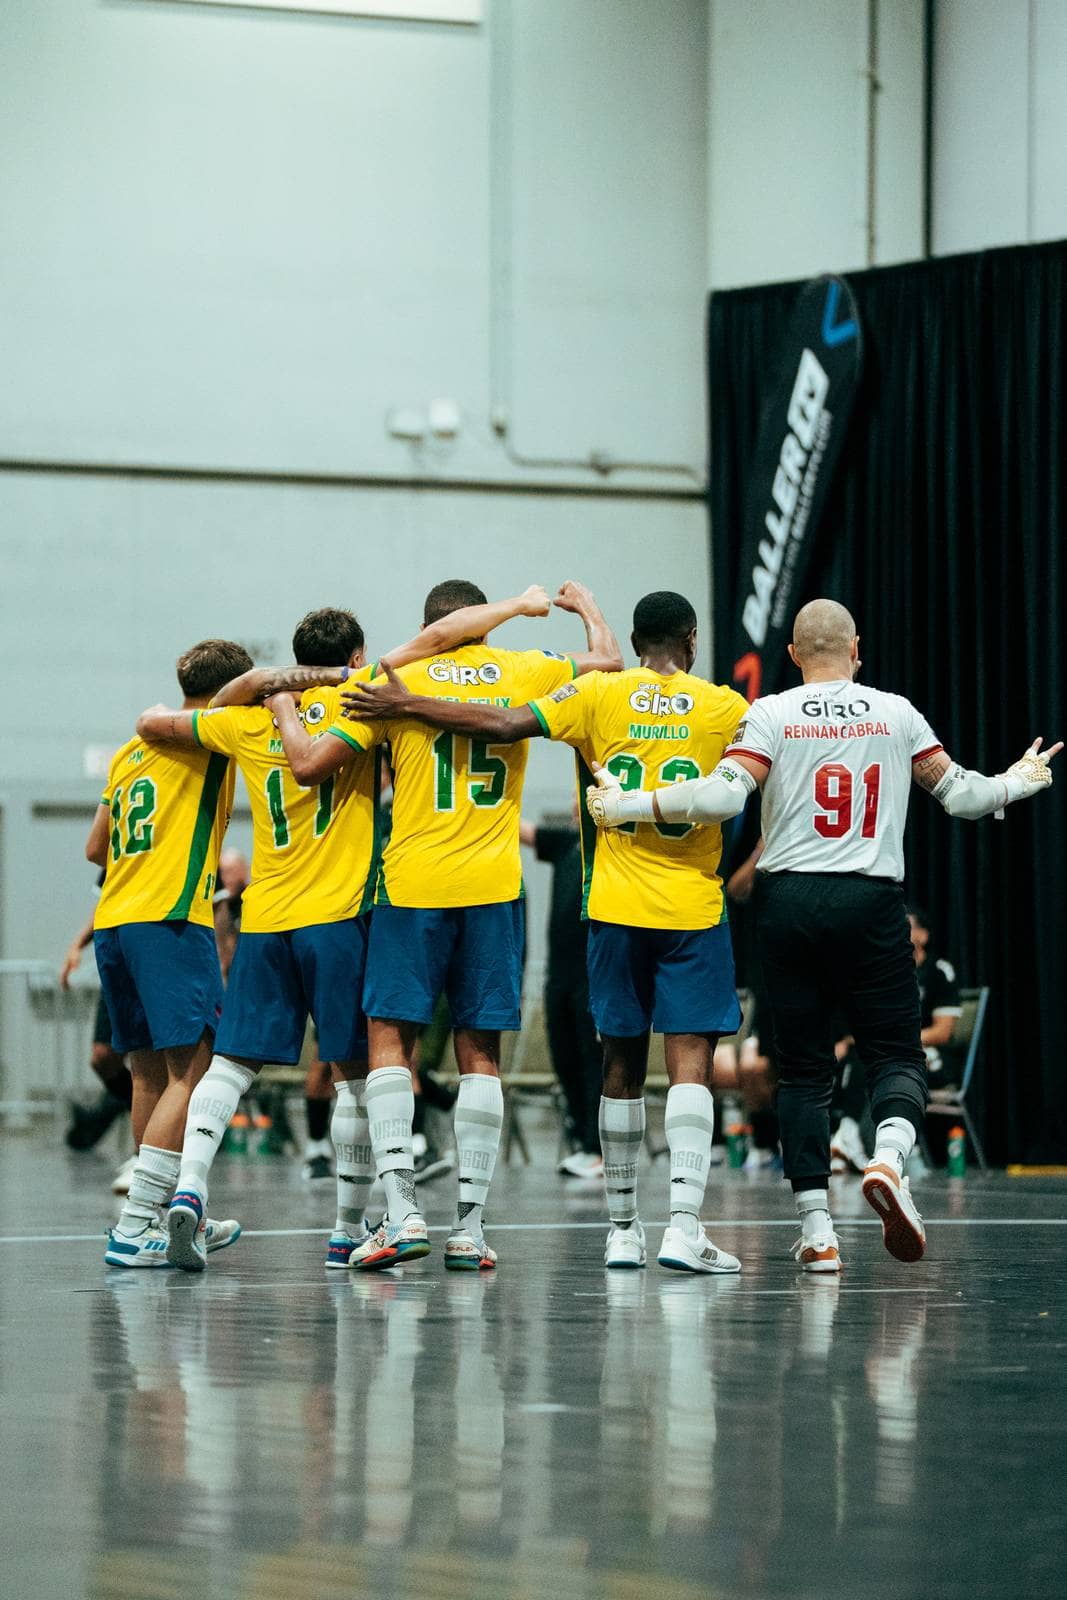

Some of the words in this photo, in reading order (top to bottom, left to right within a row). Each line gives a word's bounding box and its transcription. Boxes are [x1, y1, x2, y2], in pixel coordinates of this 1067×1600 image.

[428, 662, 502, 685] GIRO
[629, 689, 694, 717] GIRO
[801, 699, 871, 718] GIRO
[629, 723, 690, 740] MURILLO
[784, 723, 839, 740] RENNAN
[840, 720, 891, 740] CABRAL
[431, 730, 509, 813] 15
[813, 762, 882, 841] 91
[110, 776, 157, 864] 12
